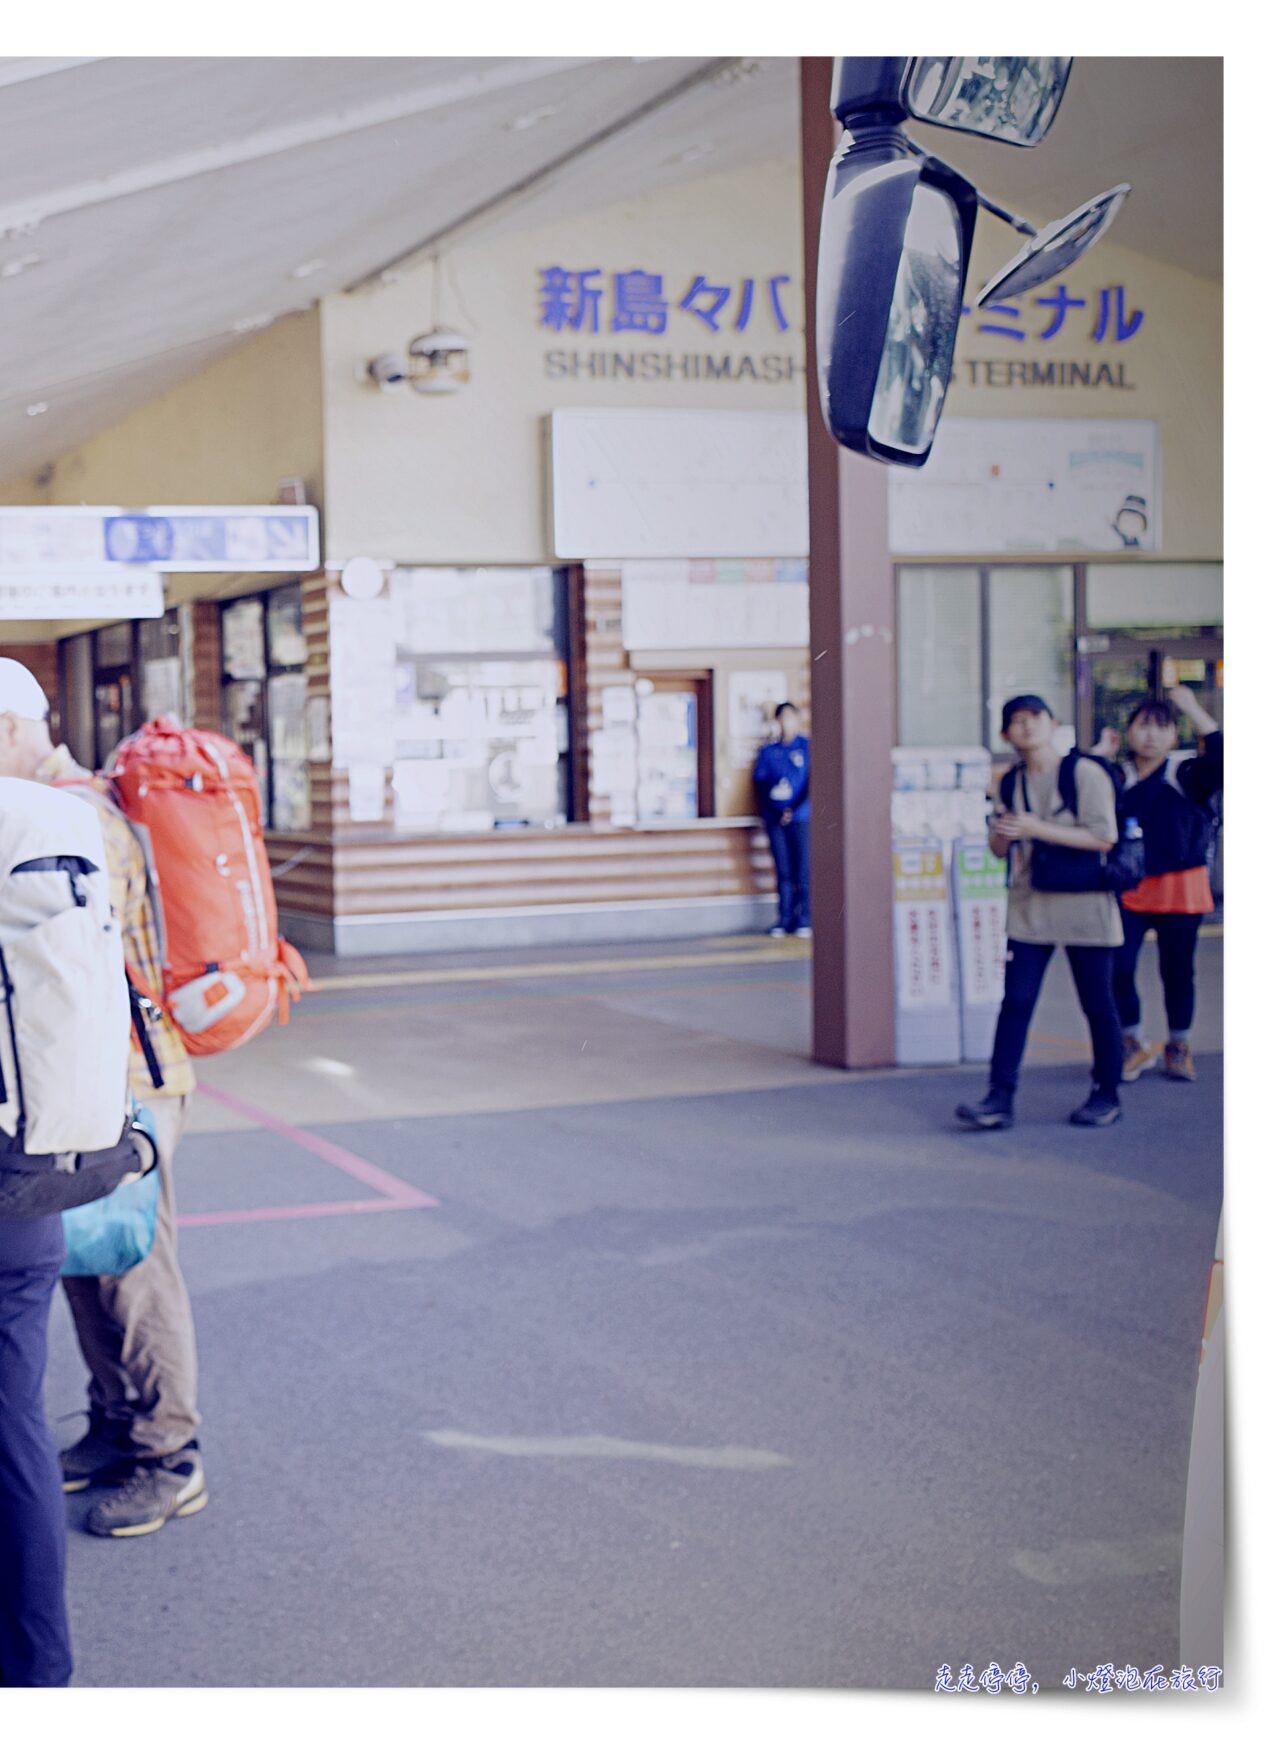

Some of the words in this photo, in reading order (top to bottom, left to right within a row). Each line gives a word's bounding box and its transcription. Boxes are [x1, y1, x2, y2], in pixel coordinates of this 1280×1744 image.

[538, 266, 1144, 342] 新島々バミナル
[544, 350, 806, 381] SHINSHIMASH
[967, 360, 1136, 390] TERMINAL
